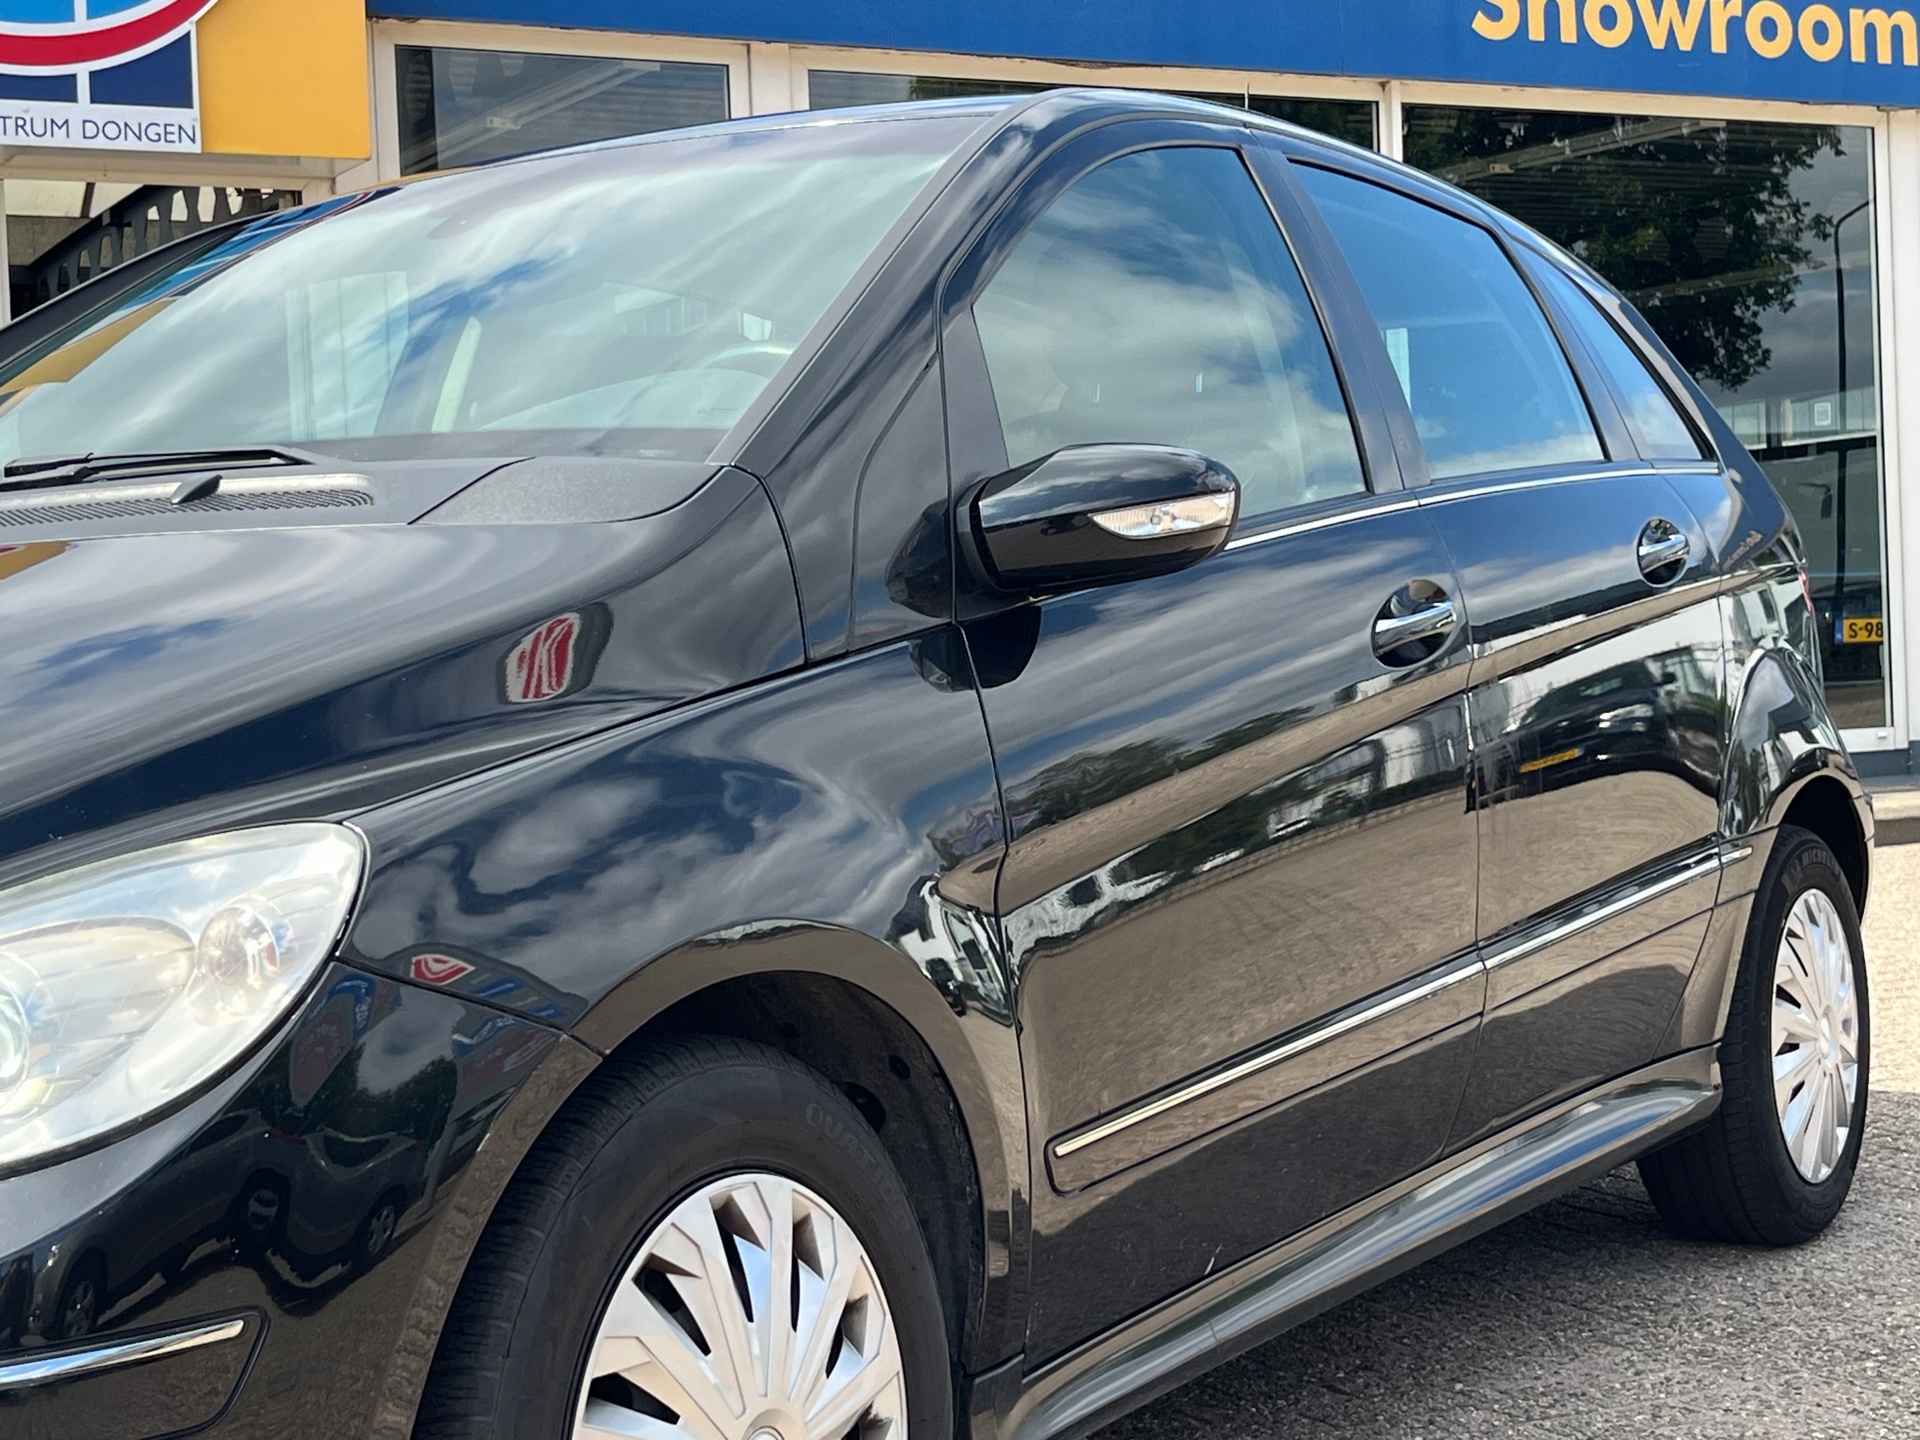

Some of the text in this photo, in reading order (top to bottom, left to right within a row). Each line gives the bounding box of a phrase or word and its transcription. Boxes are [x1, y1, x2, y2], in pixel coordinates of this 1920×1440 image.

[1472, 0, 1919, 66] Showroom
[0, 115, 197, 145] TRUM DONGEN
